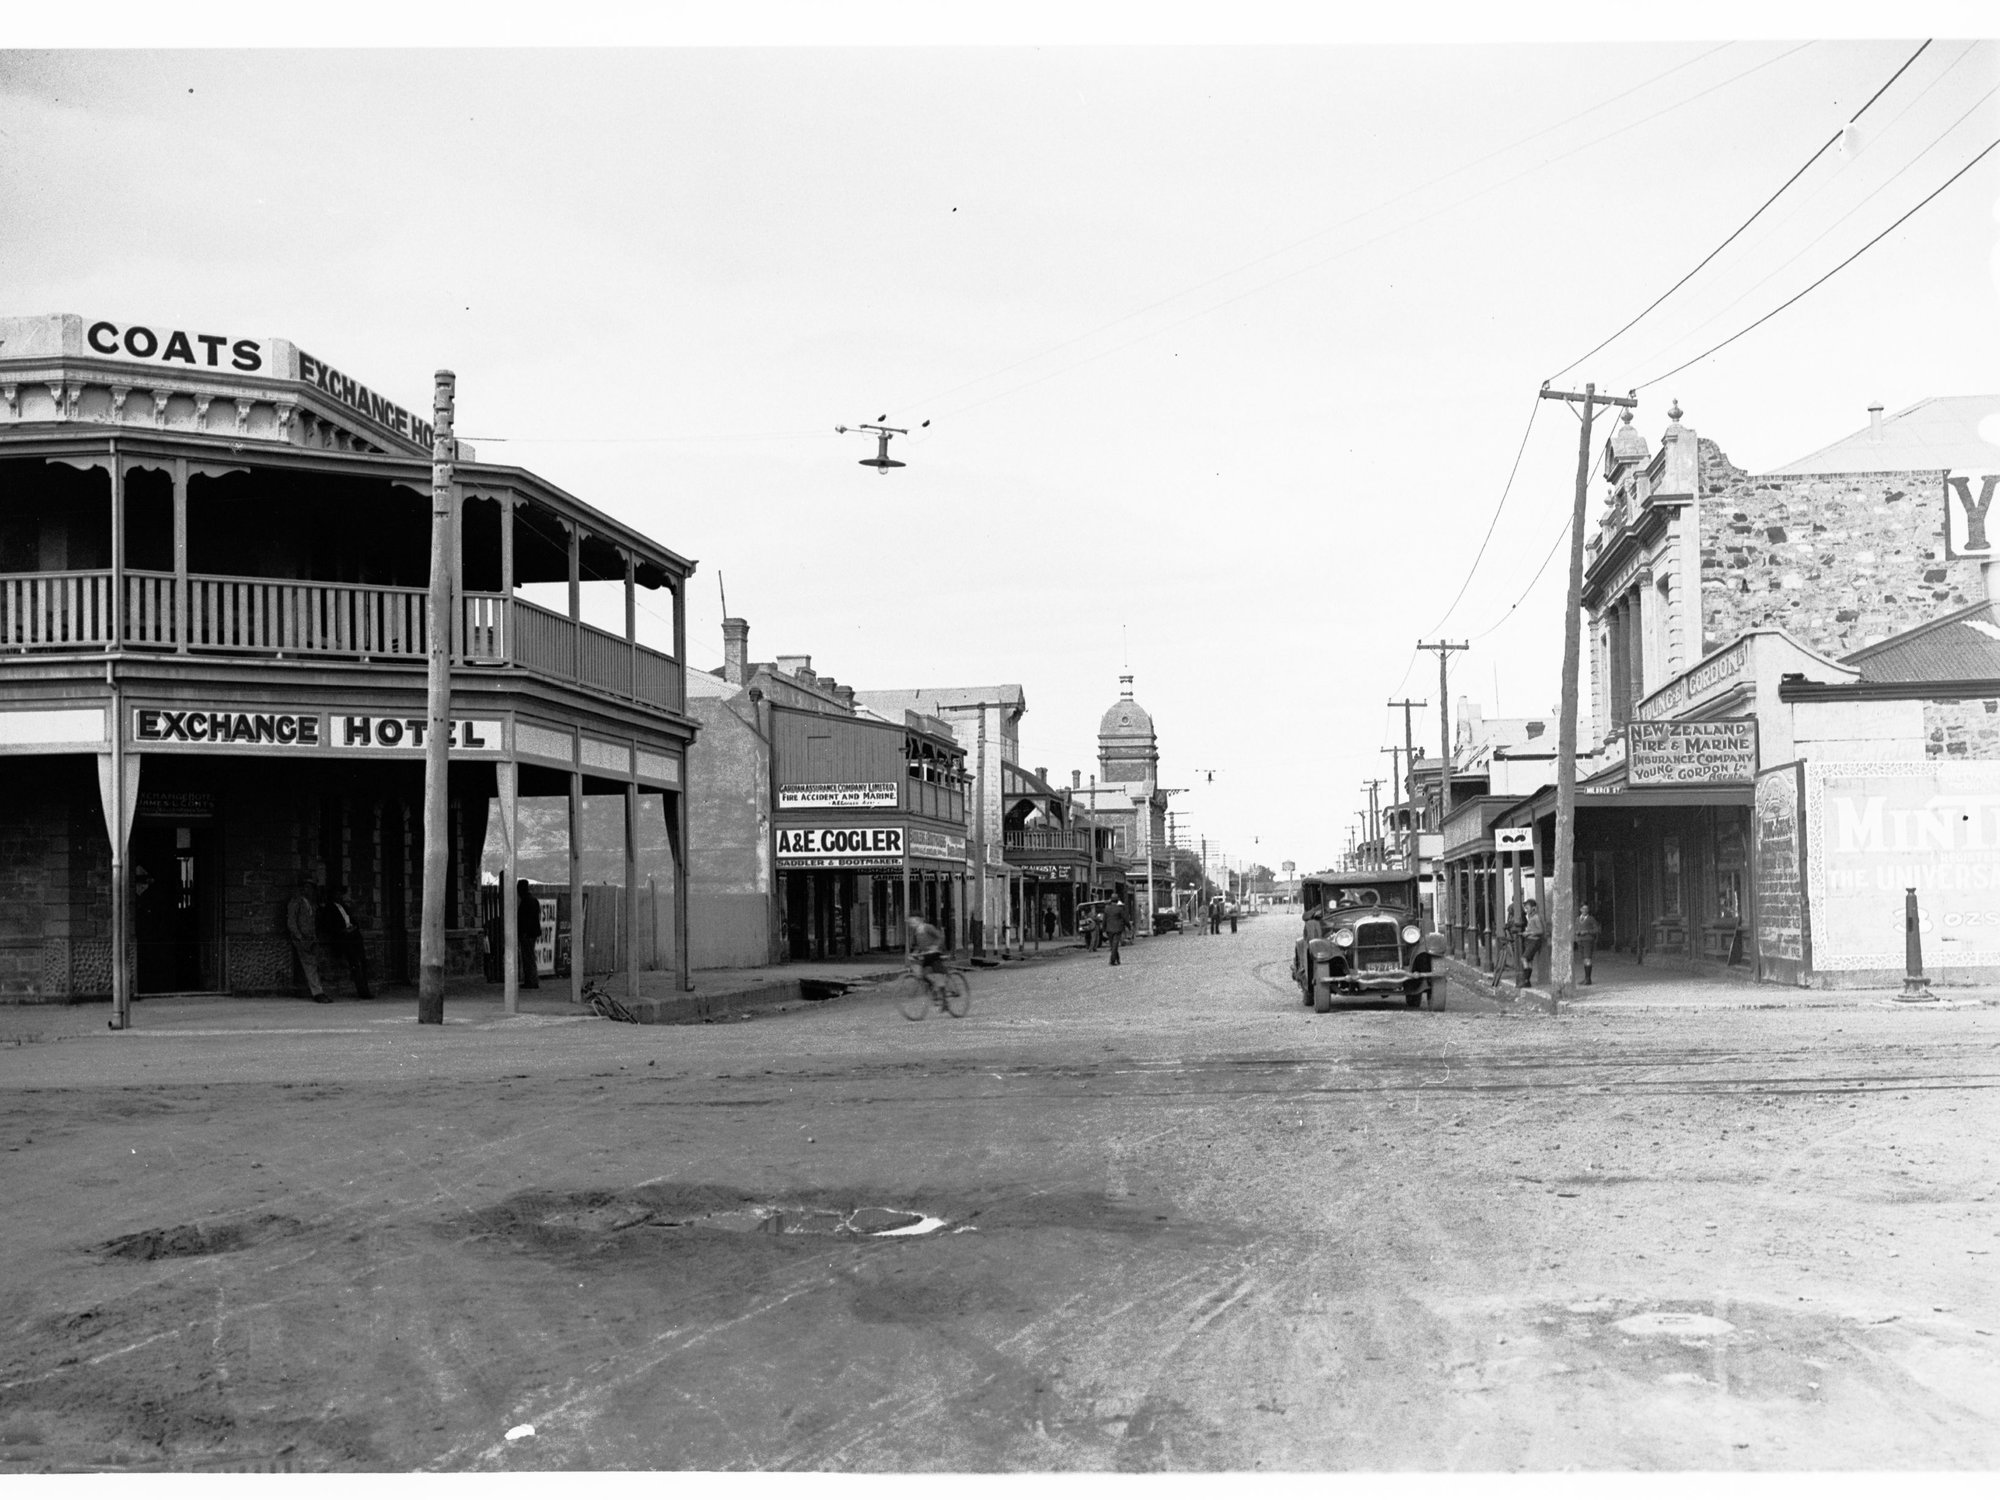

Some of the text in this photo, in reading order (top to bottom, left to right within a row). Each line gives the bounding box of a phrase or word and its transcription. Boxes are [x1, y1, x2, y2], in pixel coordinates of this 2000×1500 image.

[87, 321, 263, 371] COATS
[299, 351, 433, 448] EXCHANGE HO
[1689, 655, 1737, 694] GORDON
[137, 710, 319, 745] EXCHANGE
[1630, 724, 1745, 739] NEW ZEALAND
[1632, 737, 1749, 754] FIRE & MARINE
[1633, 753, 1753, 766] INSURANCE COMPANY
[1635, 765, 1673, 780] YOUNG
[1678, 765, 1728, 780] GORDON
[838, 783, 867, 793] COMPANY
[141, 792, 187, 801] XCHANGE
[801, 793, 838, 801] ACCIDENT
[776, 859, 825, 867] SADDLER
[1826, 870, 1870, 889] THE
